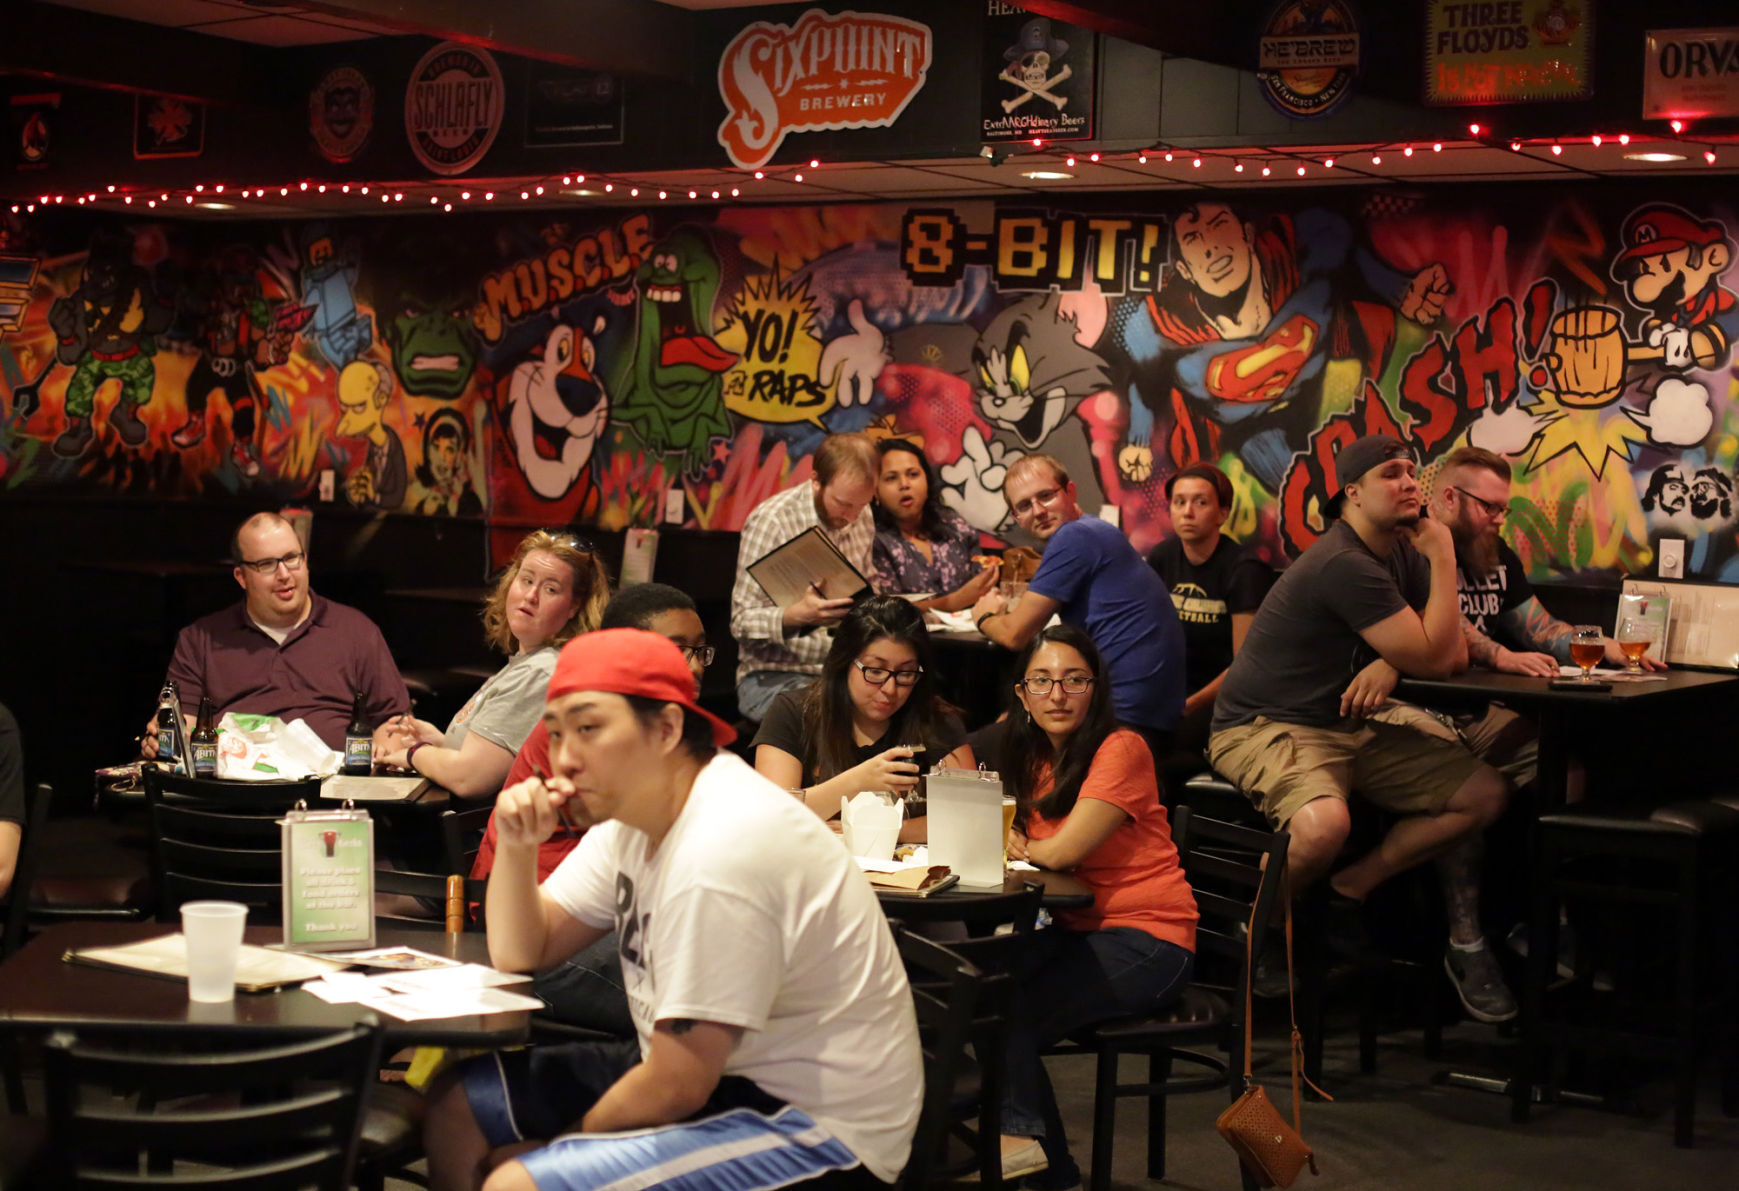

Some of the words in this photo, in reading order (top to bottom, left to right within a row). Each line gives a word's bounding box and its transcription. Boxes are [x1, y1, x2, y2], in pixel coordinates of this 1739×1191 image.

[1443, 1, 1522, 27] THREE
[1438, 26, 1529, 54] FLOYDS
[414, 81, 493, 129] SCHLAFLY
[733, 21, 920, 150] SIXPOINT
[799, 93, 887, 111] BREWERY
[905, 215, 1159, 282] 8-BIT!
[742, 308, 799, 364] YO!
[748, 368, 826, 407] RAPS
[1458, 592, 1499, 616] CLUB
